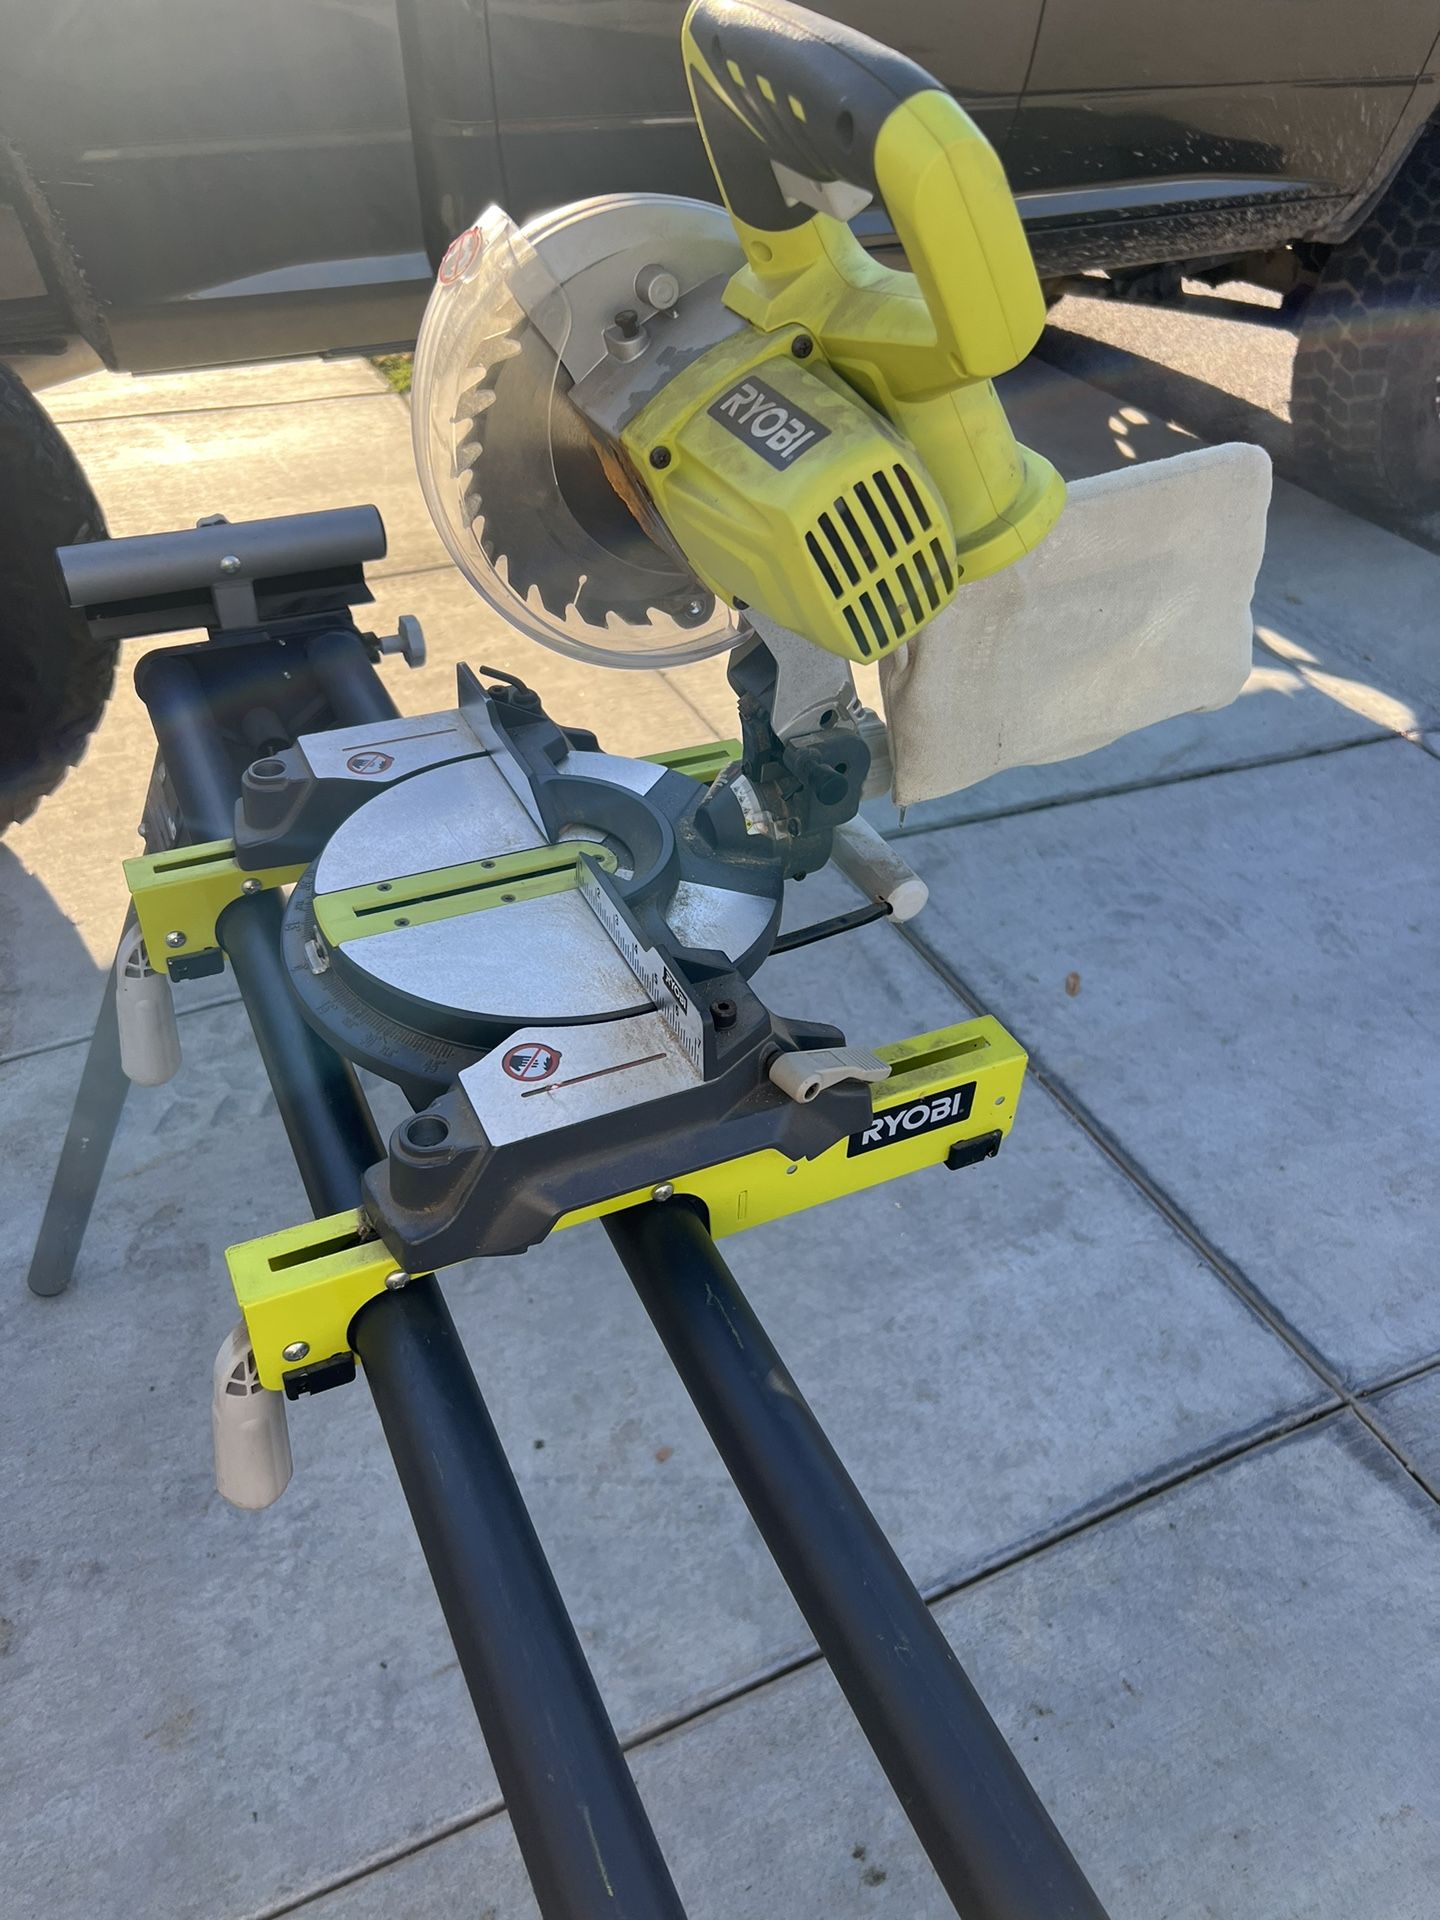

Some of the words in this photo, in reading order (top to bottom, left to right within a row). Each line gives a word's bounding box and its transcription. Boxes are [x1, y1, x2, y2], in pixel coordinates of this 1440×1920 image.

[719, 383, 816, 459] RYOBI
[665, 970, 686, 1010] RYOBI
[861, 1092, 962, 1146] RYOBI
